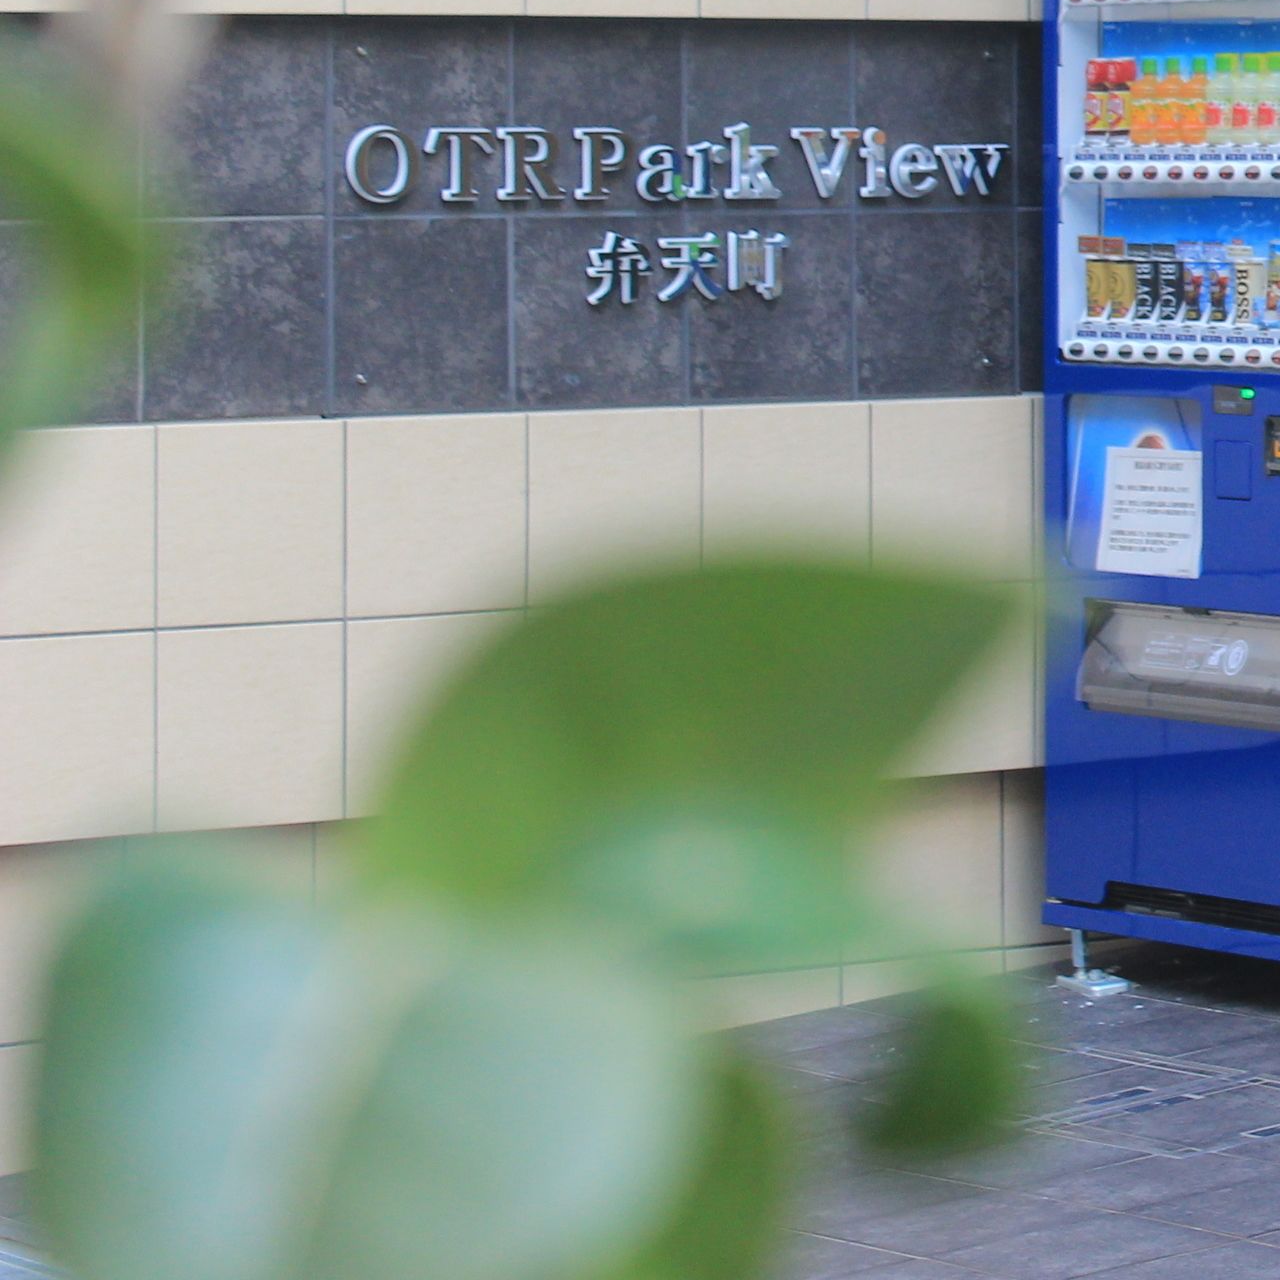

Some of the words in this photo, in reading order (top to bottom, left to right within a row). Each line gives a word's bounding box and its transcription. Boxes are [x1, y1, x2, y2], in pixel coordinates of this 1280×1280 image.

[344, 124, 566, 204] OTR
[574, 122, 783, 202] Park
[791, 127, 1010, 200] View
[586, 229, 789, 304] 弁天町
[1136, 263, 1152, 320] BLACK
[1160, 263, 1177, 320] BLACK
[1237, 268, 1249, 319] BOSS
